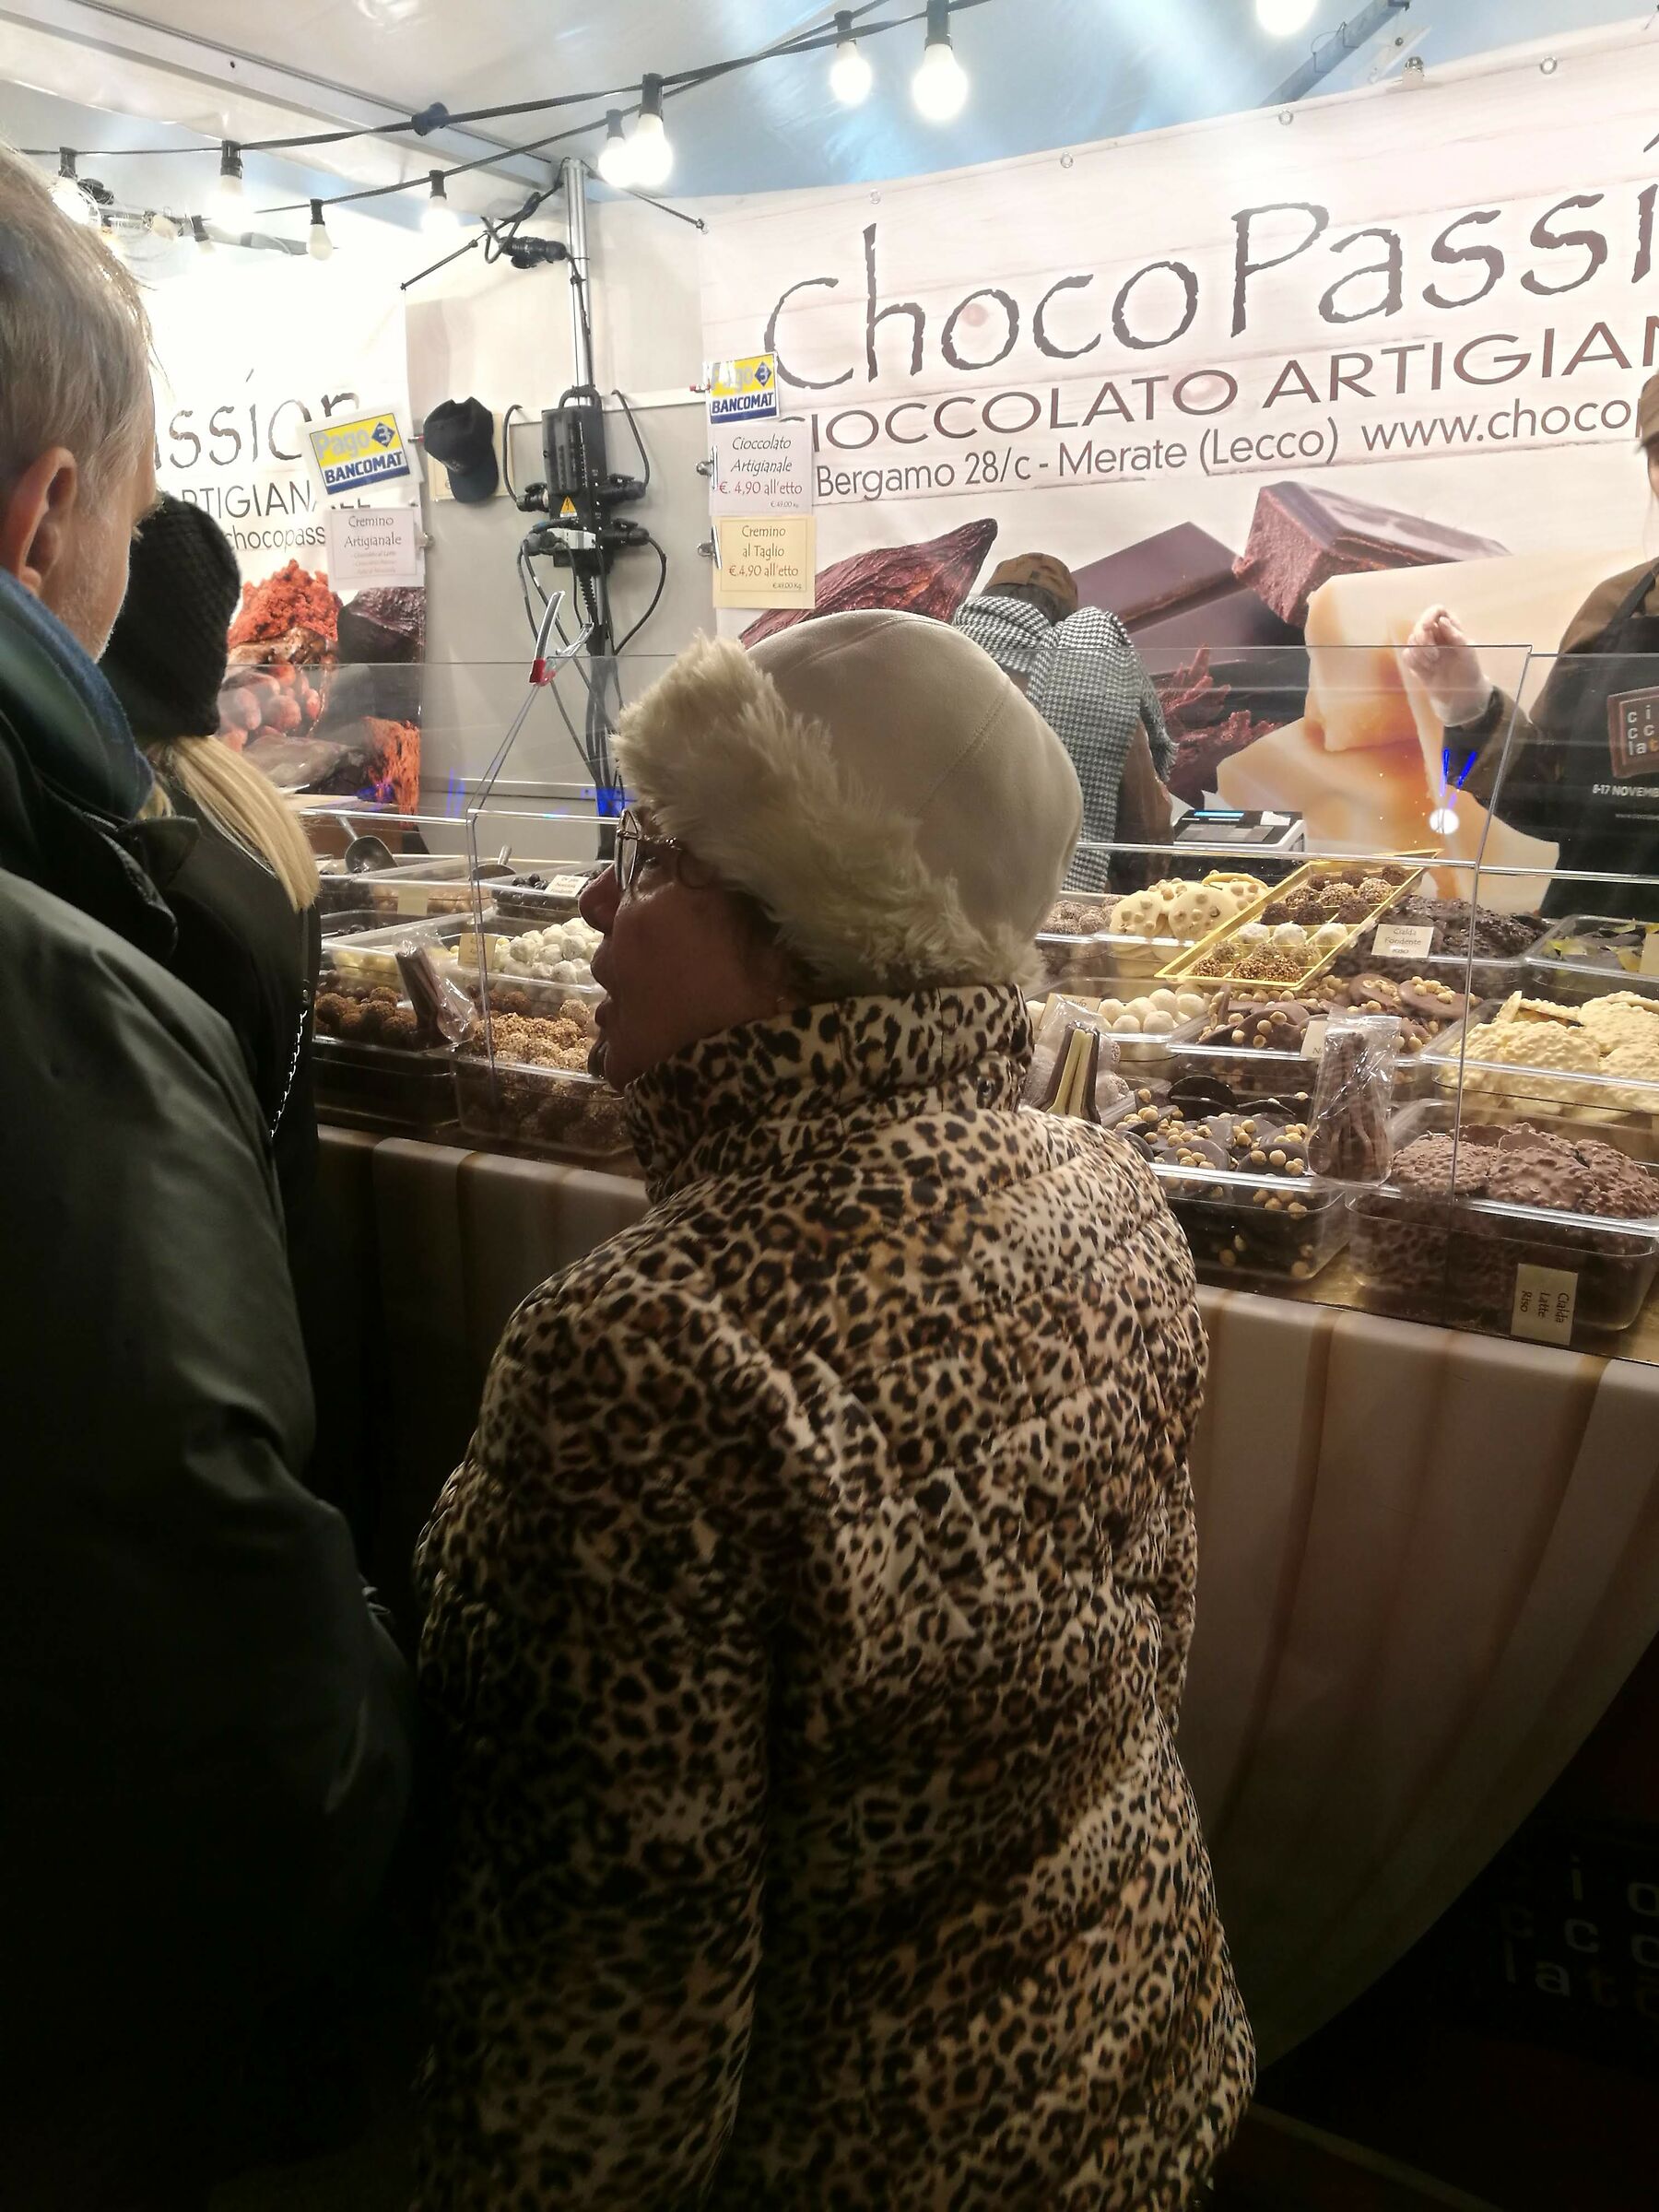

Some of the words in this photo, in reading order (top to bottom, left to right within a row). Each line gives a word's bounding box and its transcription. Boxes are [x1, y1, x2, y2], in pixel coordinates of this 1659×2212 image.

[712, 393, 774, 414] BANCOMAT
[780, 369, 1239, 453] IOCCOLATO
[315, 428, 369, 460] Pago
[732, 433, 791, 452] Cioccolato
[324, 451, 403, 484] BANCOMAT
[730, 458, 793, 477] Artigianale
[817, 461, 955, 501] Bergamo
[964, 447, 1030, 486] 28/c
[1059, 438, 1188, 477] Merate
[1199, 417, 1338, 477] (Lecco)
[719, 481, 732, 495] €.
[735, 480, 761, 497] 4,90
[764, 478, 803, 497] all'etto
[348, 516, 394, 528] Cremino
[741, 524, 786, 538] Cremino
[344, 532, 402, 550] Artigianale
[743, 544, 751, 558] al
[754, 544, 785, 561] Taglio
[765, 564, 799, 579] all'etto
[1384, 936, 1422, 946] Fondente
[1520, 1290, 1533, 1312] Riso
[1538, 1291, 1551, 1318] Latte
[1555, 1292, 1571, 1324] Cialda
